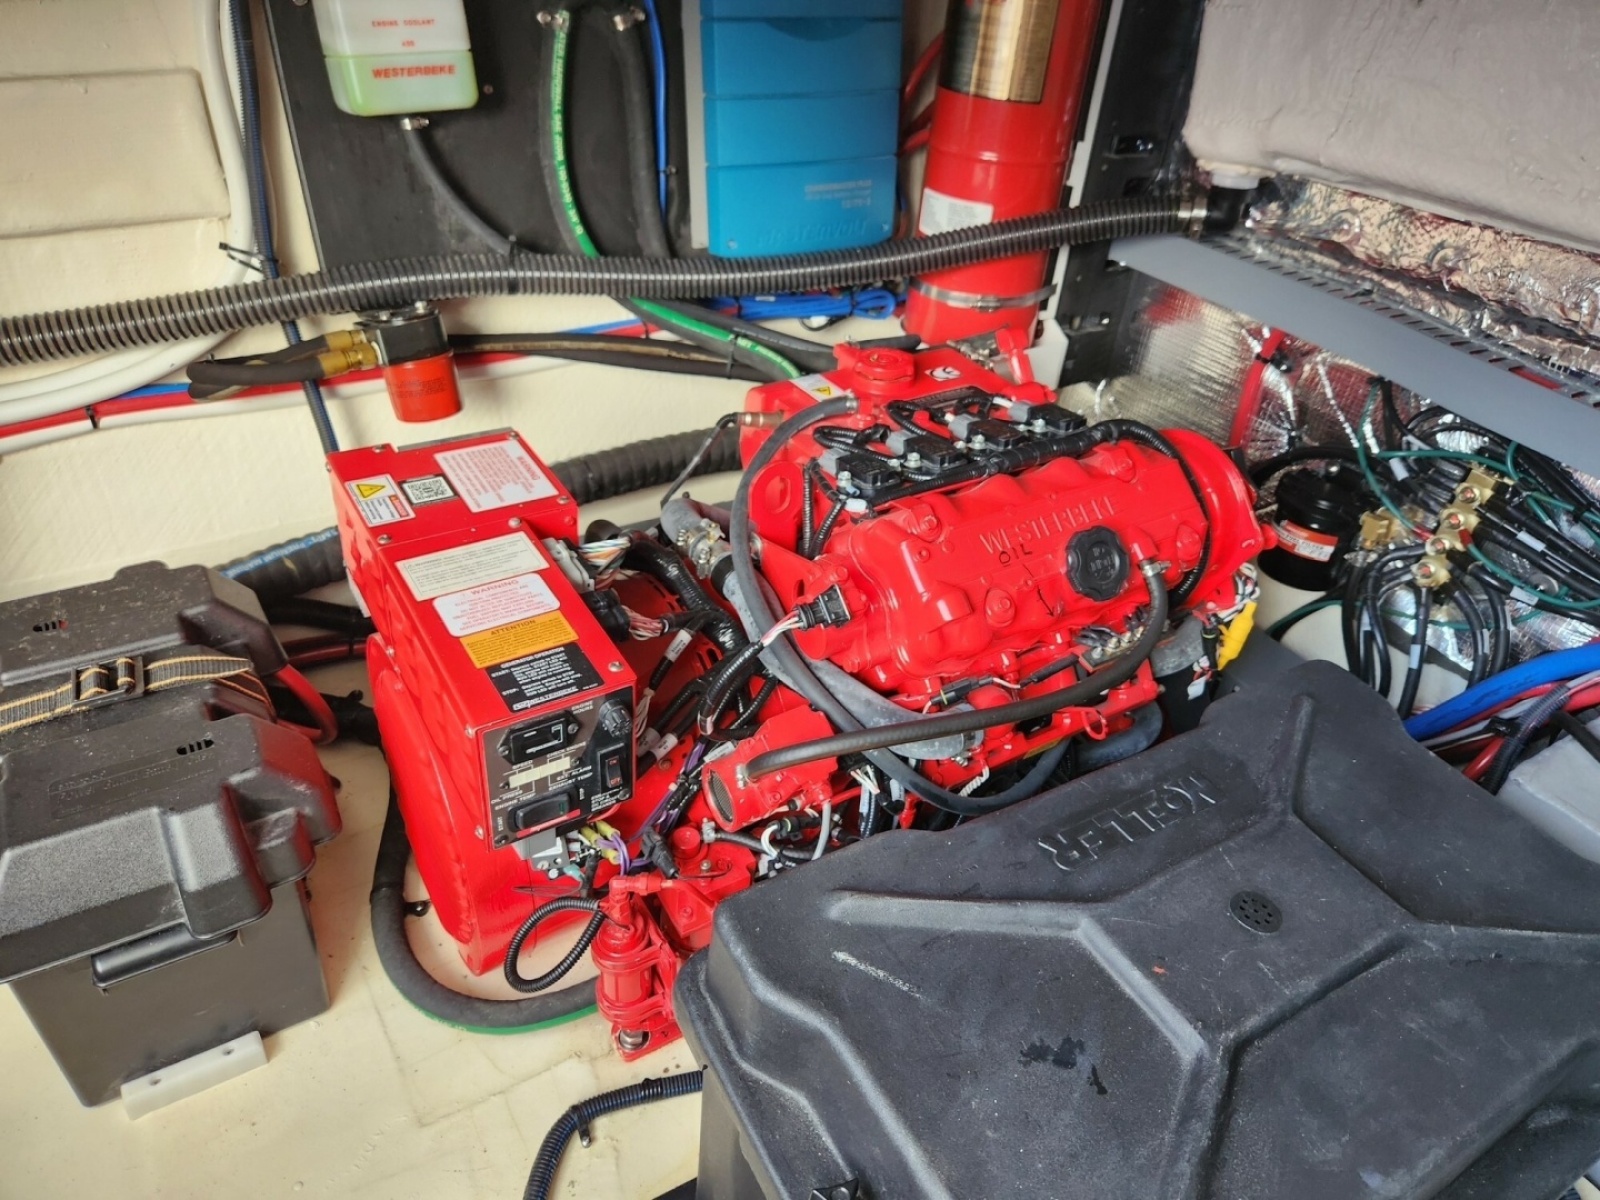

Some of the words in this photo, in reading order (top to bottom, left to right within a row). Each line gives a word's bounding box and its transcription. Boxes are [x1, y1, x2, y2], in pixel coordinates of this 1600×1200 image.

[371, 64, 456, 79] WESTERBEKE
[999, 543, 1033, 564] OIL
[471, 580, 519, 595] WARNING
[490, 620, 536, 635] ATTENTION
[512, 760, 533, 769] SPEED
